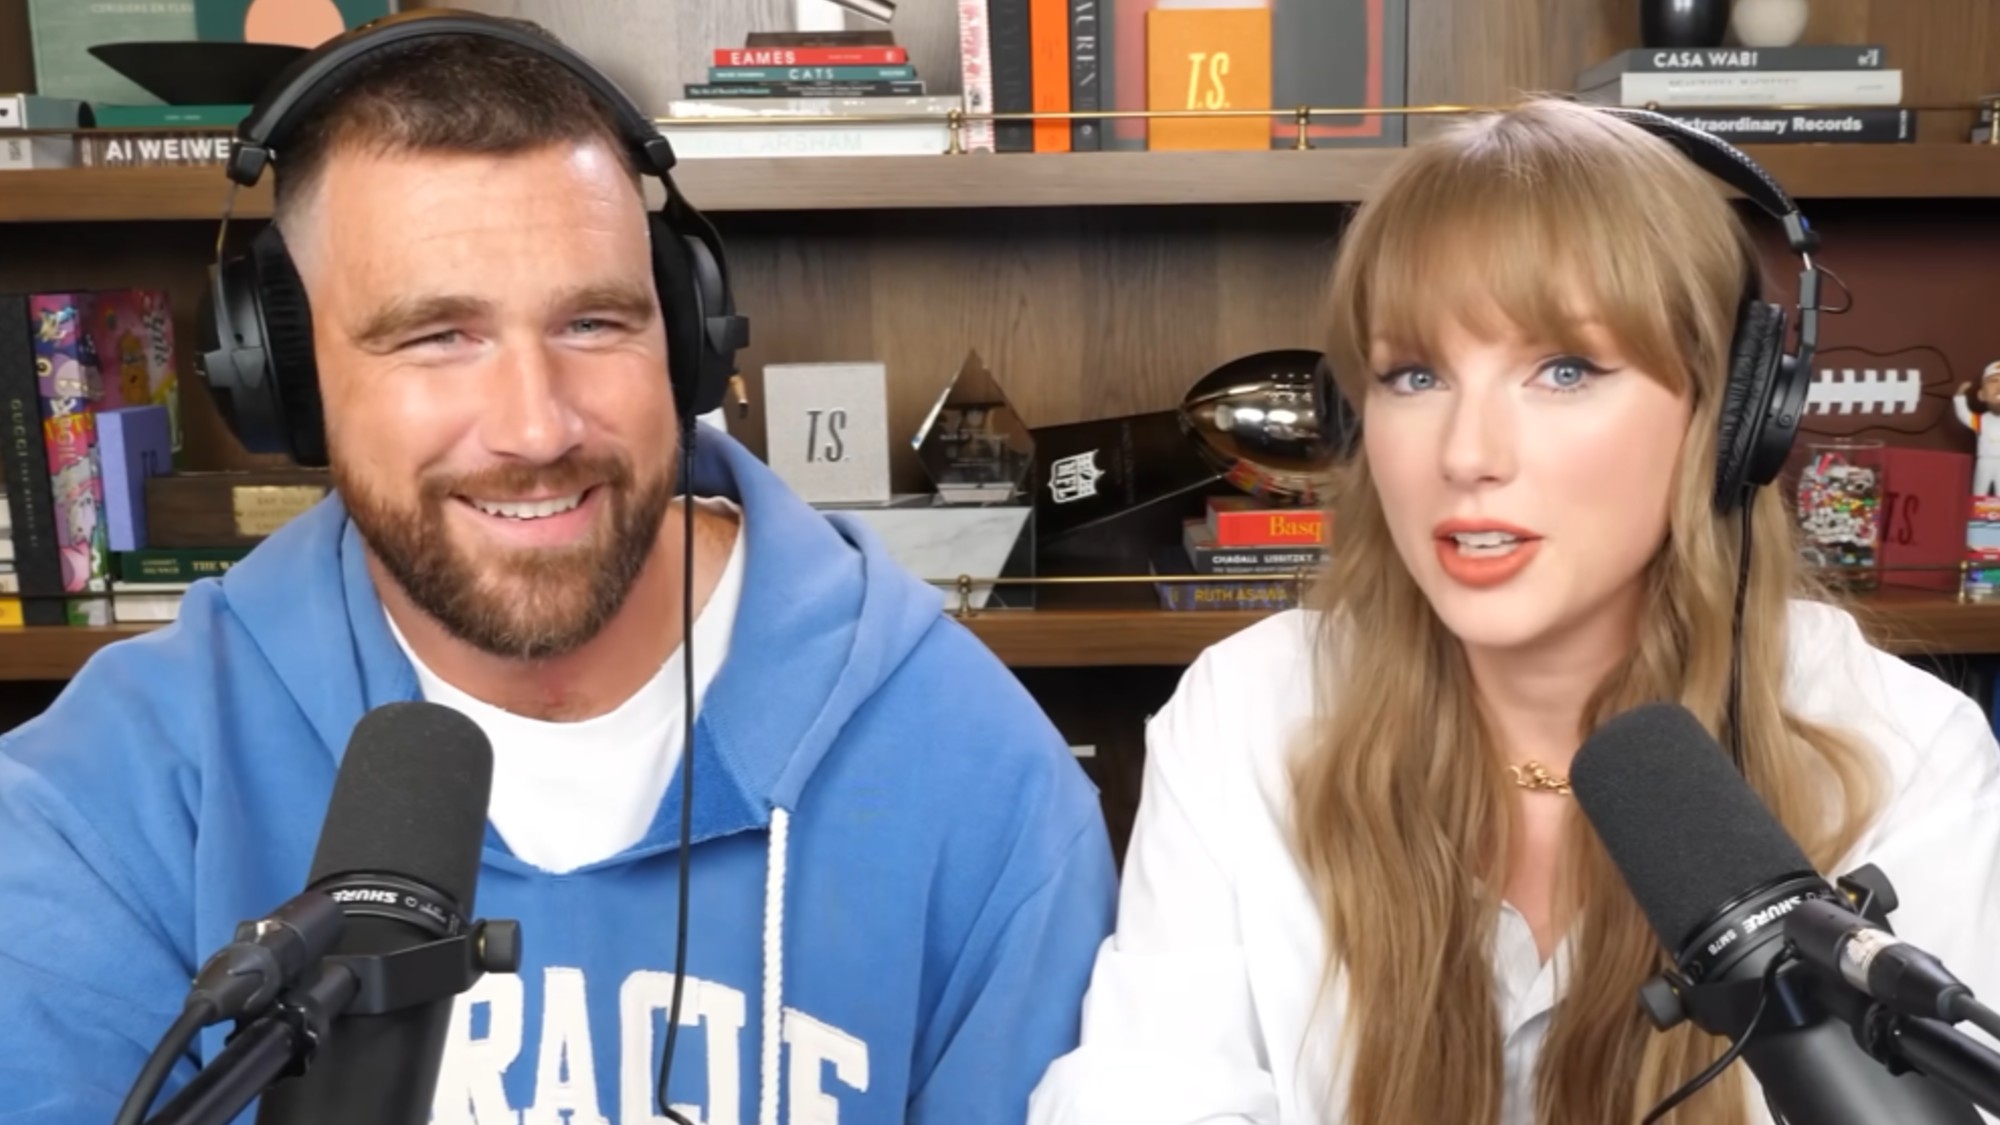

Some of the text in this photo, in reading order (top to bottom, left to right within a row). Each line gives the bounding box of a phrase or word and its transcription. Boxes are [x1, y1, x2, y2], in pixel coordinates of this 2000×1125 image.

[731, 51, 796, 65] EAMES
[1653, 51, 1759, 68] CASA WABI
[788, 69, 834, 80] CATS
[1673, 117, 1862, 134] xtraordinary Records
[105, 138, 131, 160] AI
[138, 137, 238, 160] WEIWE
[11, 399, 28, 457] GUCCI
[1194, 587, 1232, 602] RUTH
[1236, 587, 1287, 601] ASAWA
